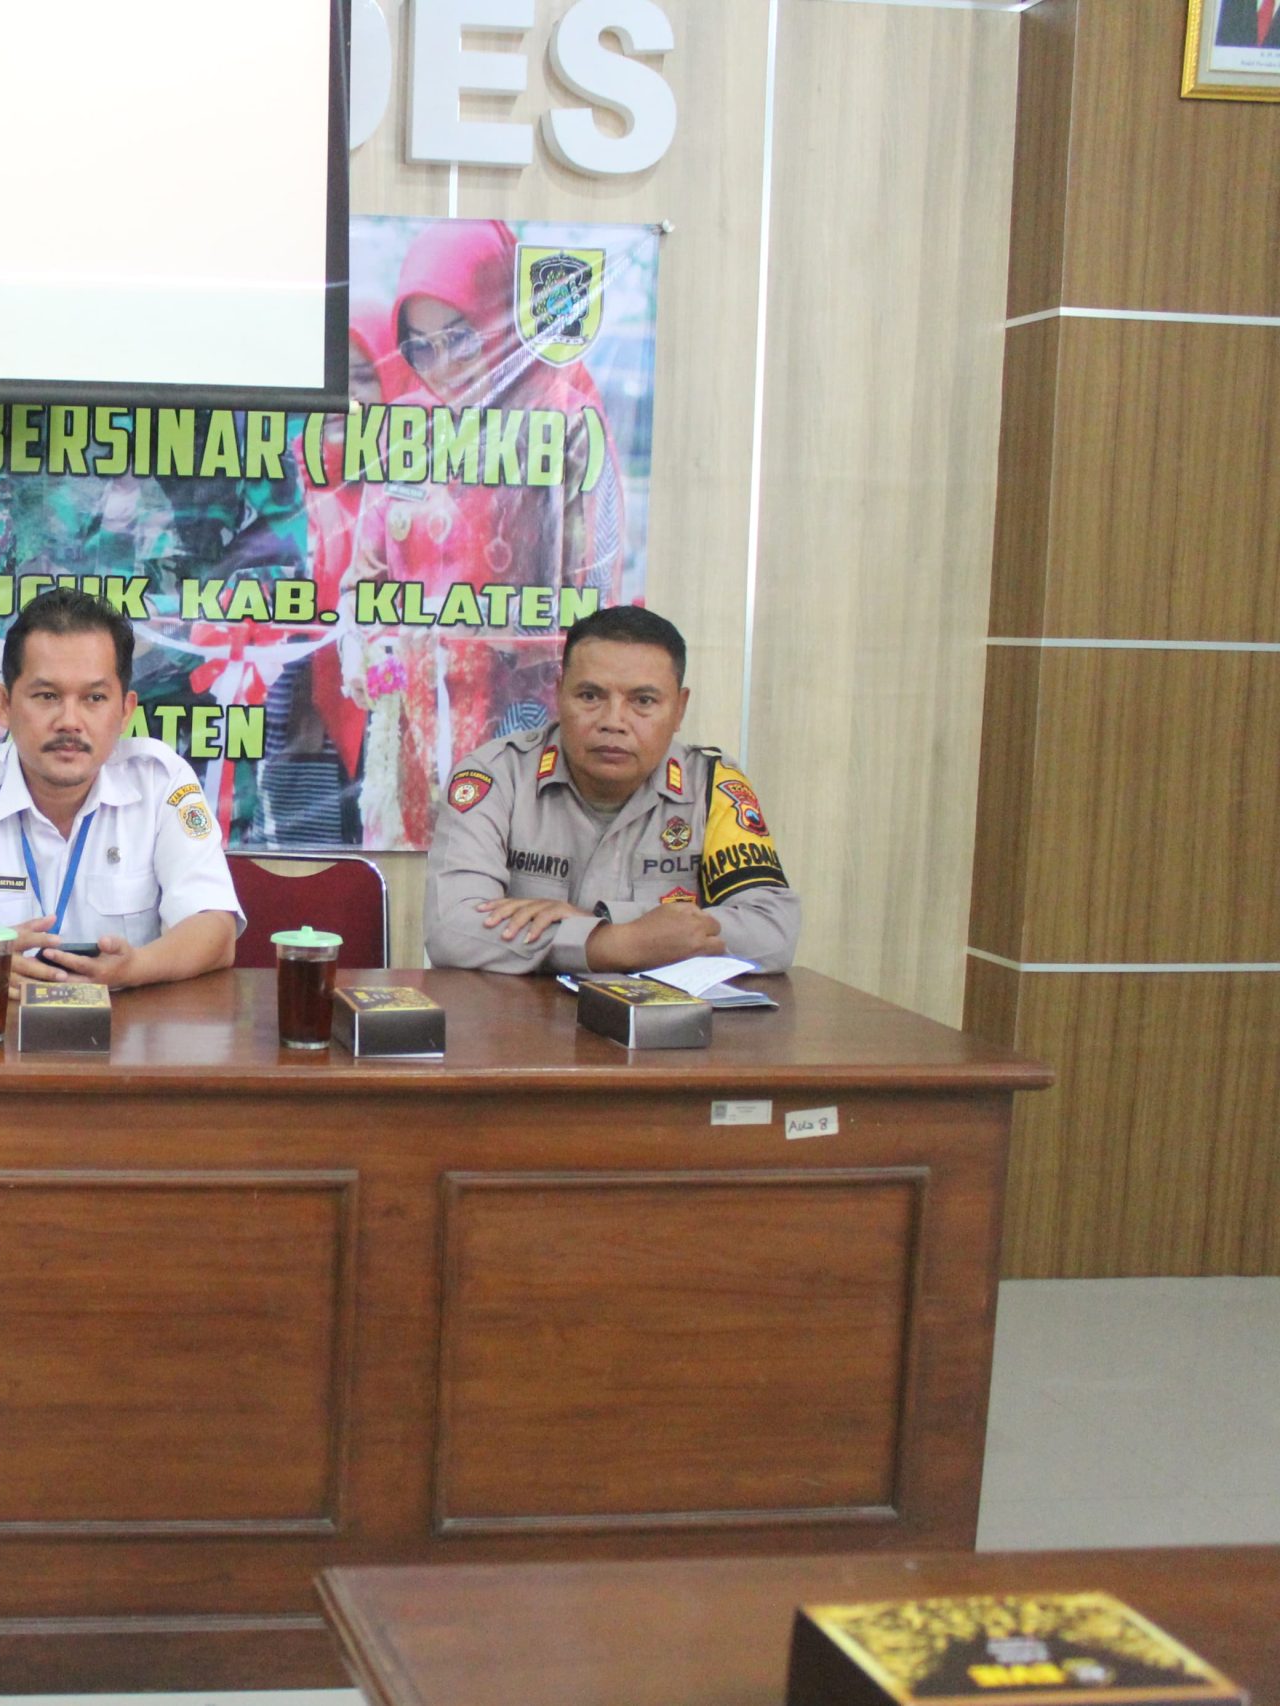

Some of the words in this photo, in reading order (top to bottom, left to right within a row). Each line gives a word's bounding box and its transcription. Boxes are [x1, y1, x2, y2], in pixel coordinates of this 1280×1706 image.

[181, 577, 340, 625] KAB.
[355, 579, 601, 628] KLATEN
[506, 848, 569, 878] UGIHARTO
